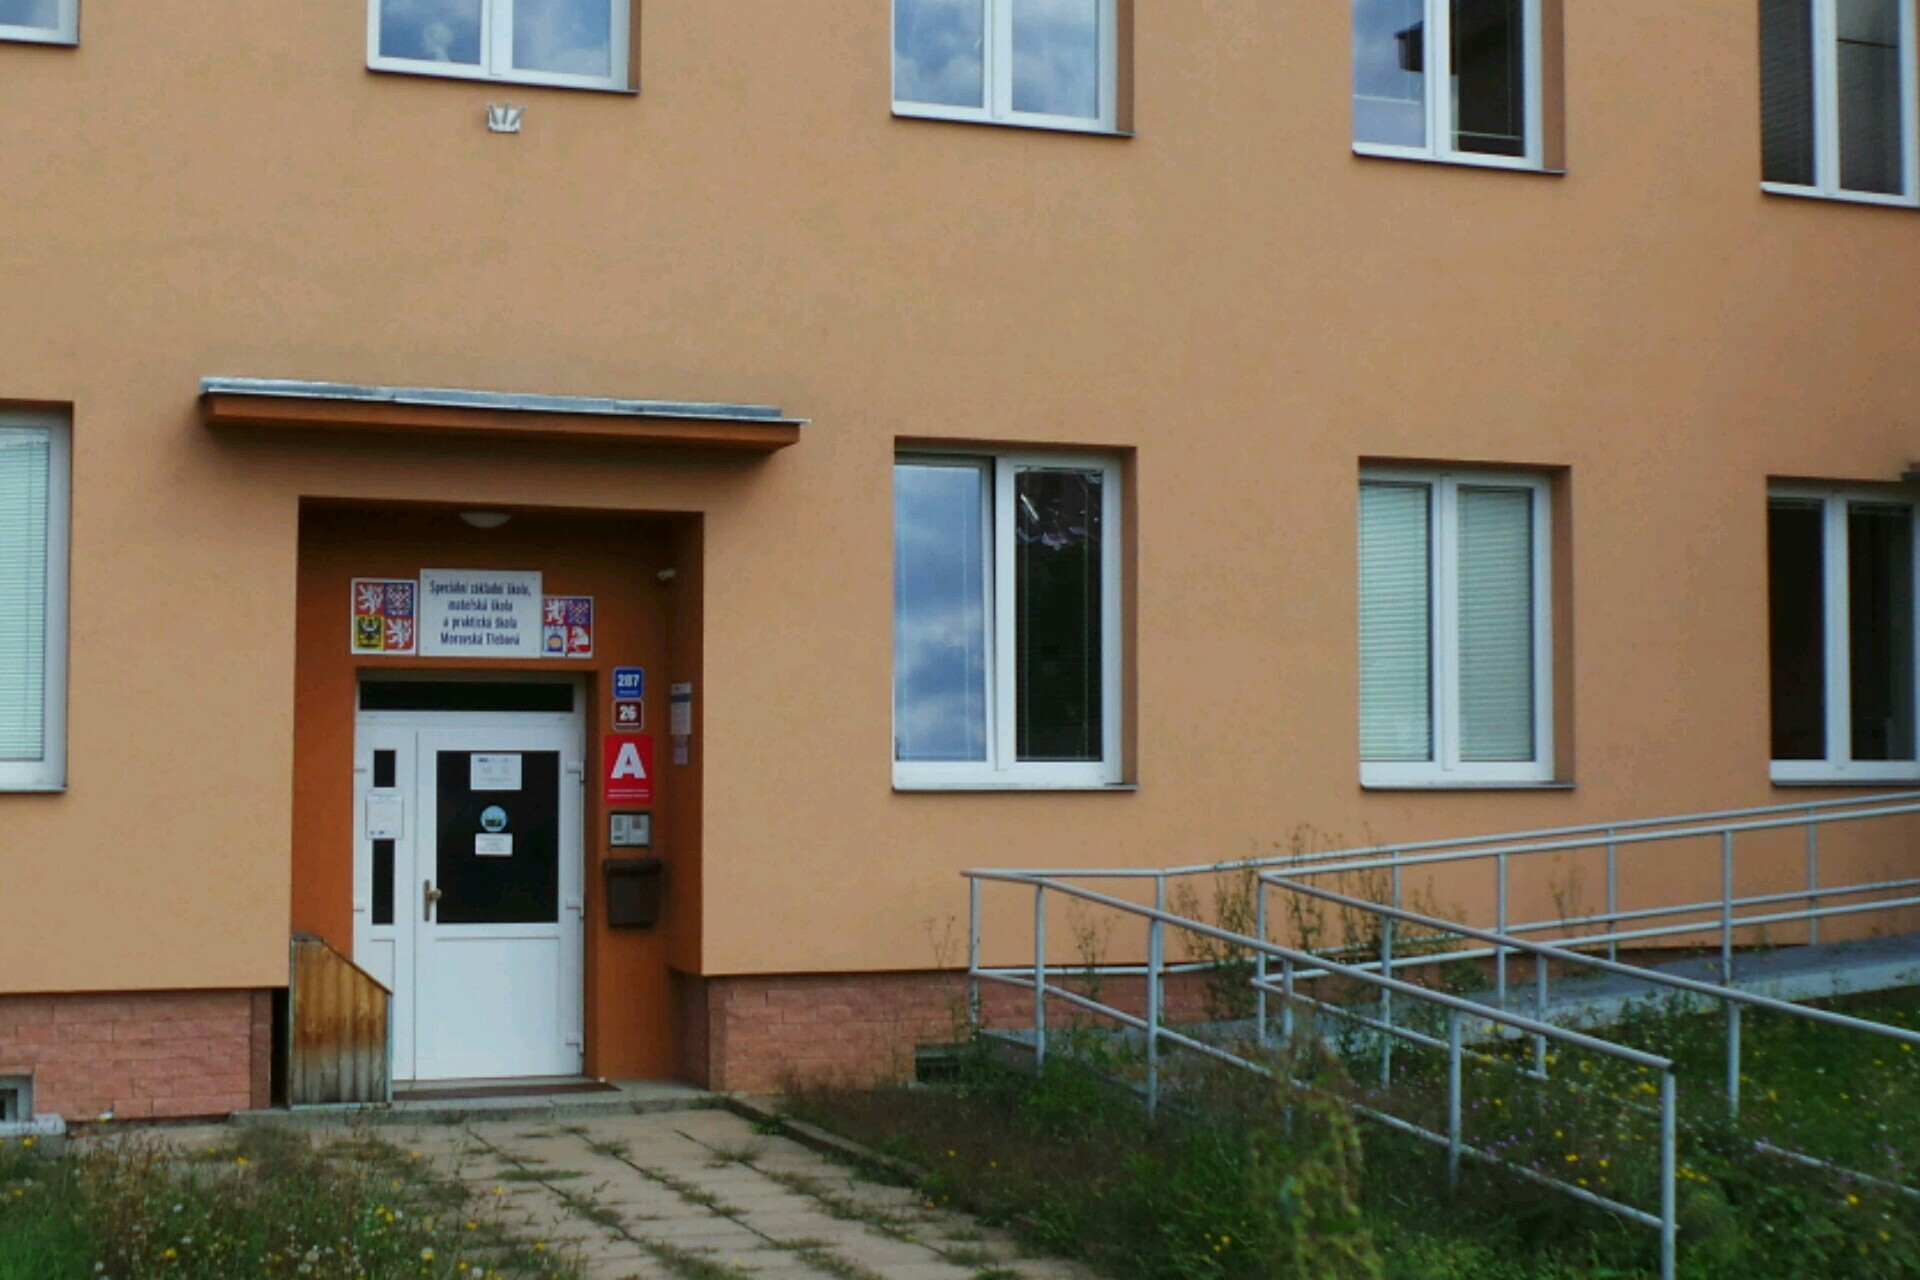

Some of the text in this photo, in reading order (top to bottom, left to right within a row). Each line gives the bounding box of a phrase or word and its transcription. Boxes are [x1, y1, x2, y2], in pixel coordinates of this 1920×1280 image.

[491, 598, 513, 611] škola
[443, 618, 449, 627] a
[495, 616, 517, 629] škola
[617, 673, 640, 687] 287
[619, 705, 637, 721] 26
[610, 742, 647, 779] A
